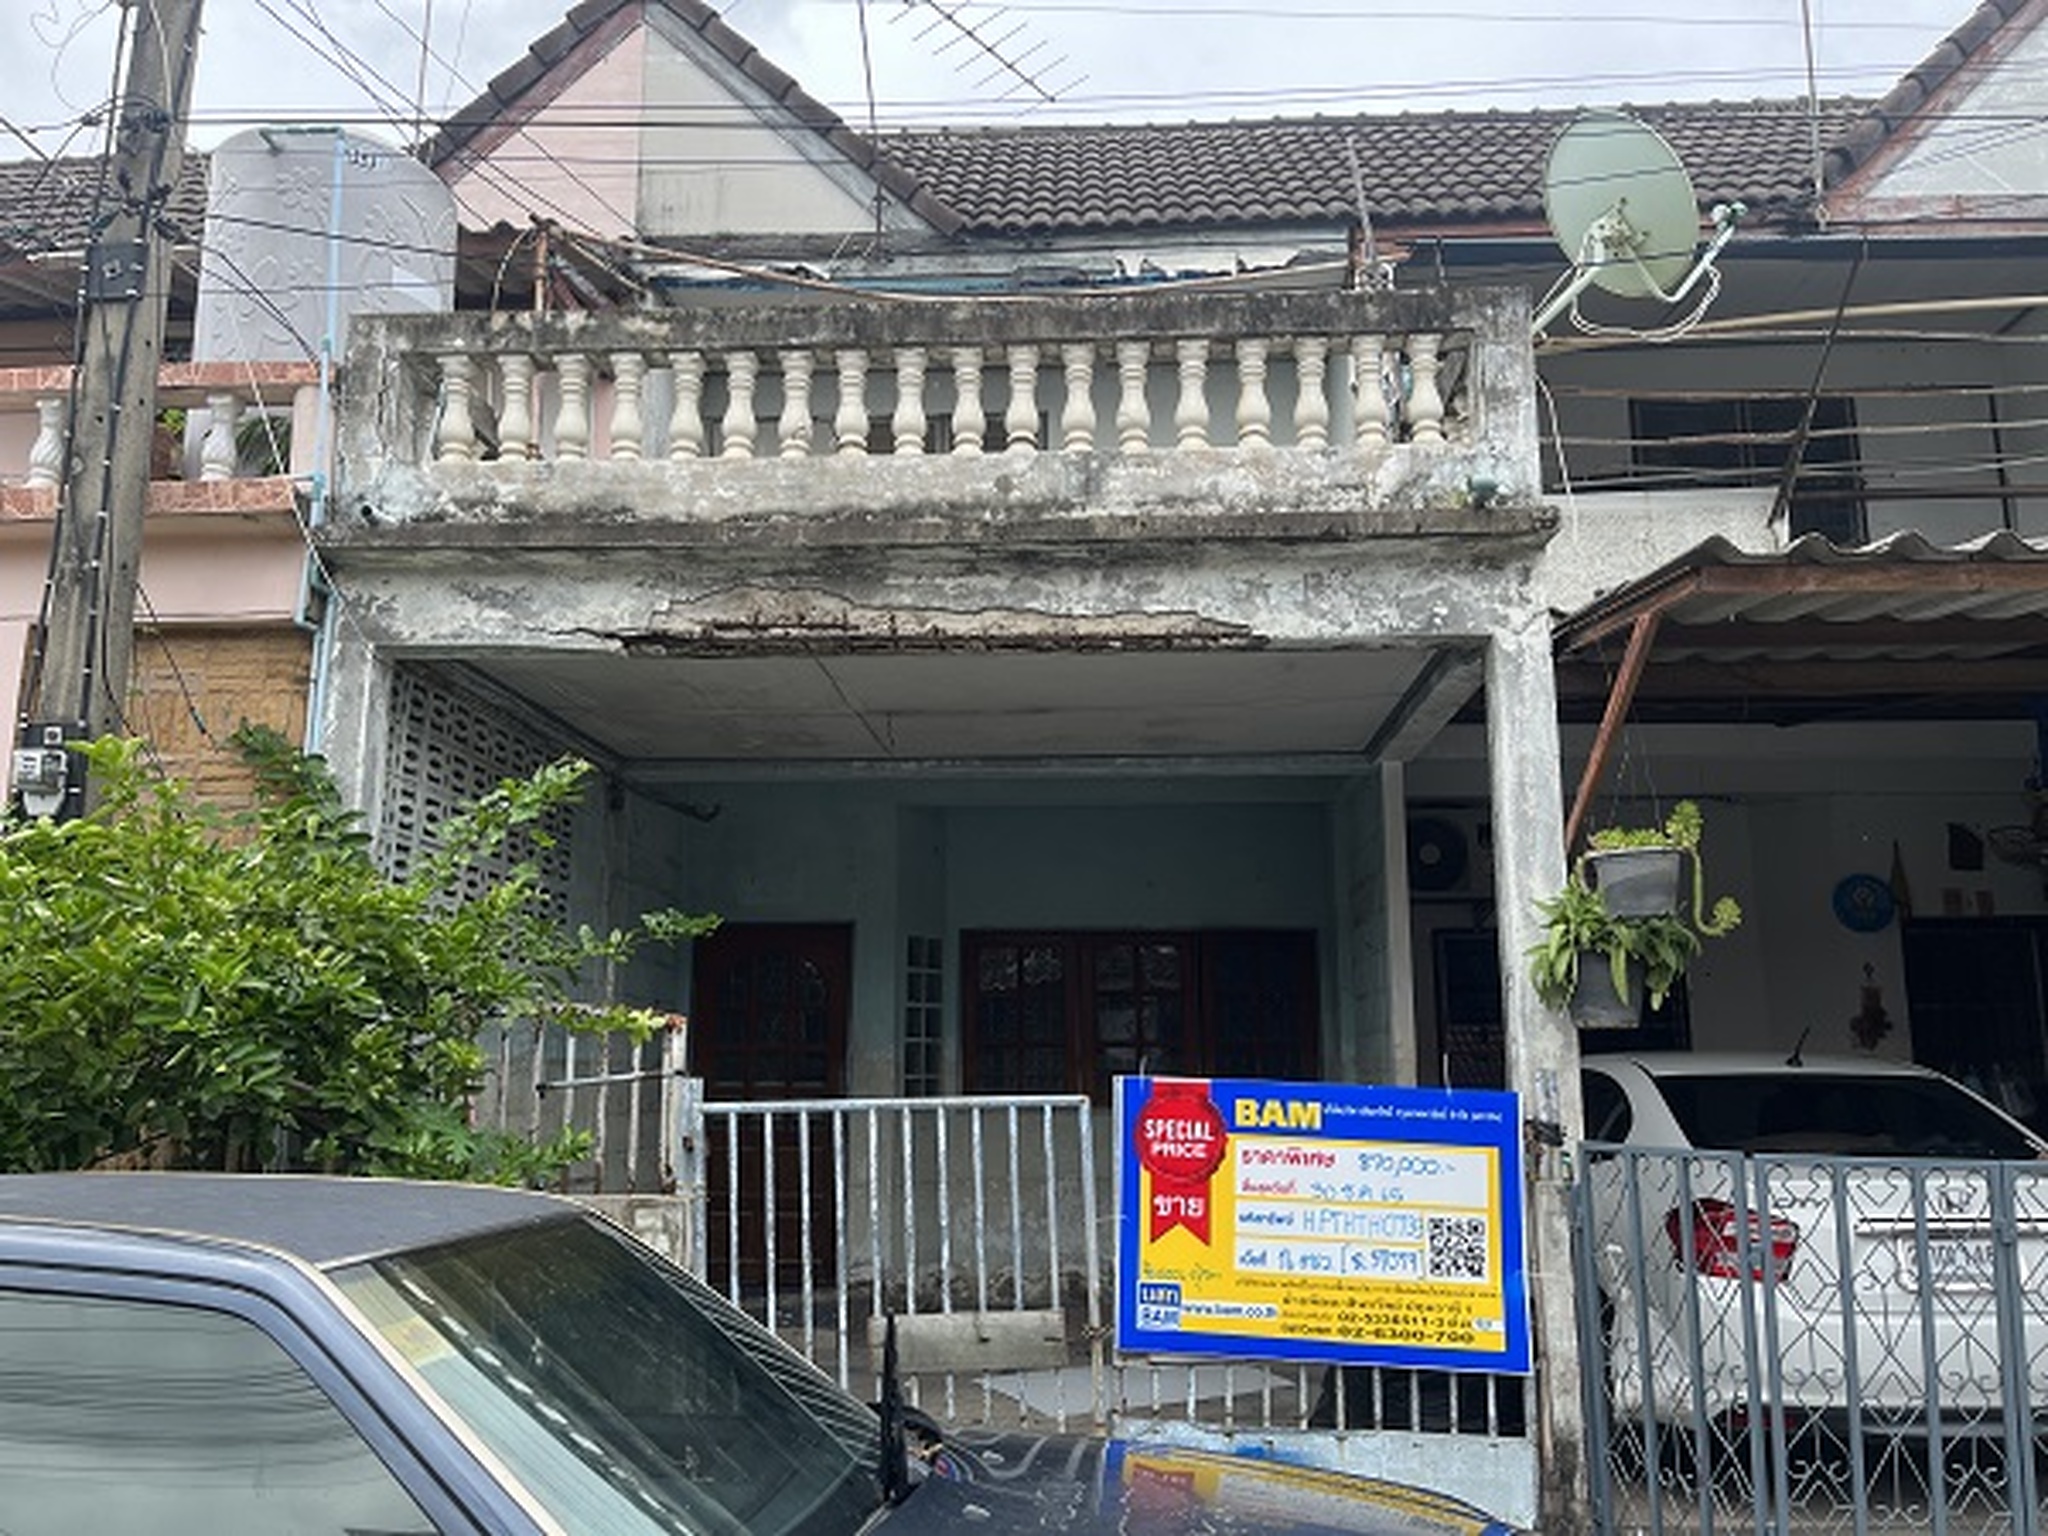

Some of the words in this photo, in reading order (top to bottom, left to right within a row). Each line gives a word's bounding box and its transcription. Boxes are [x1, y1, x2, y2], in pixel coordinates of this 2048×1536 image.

[1235, 1099, 1322, 1129] BAM
[1144, 1118, 1215, 1141] SPECIAL
[1150, 1141, 1207, 1159] PRICE
[1241, 1147, 1336, 1167] ราคาพิเศษ
[1153, 1194, 1205, 1217] ขาย
